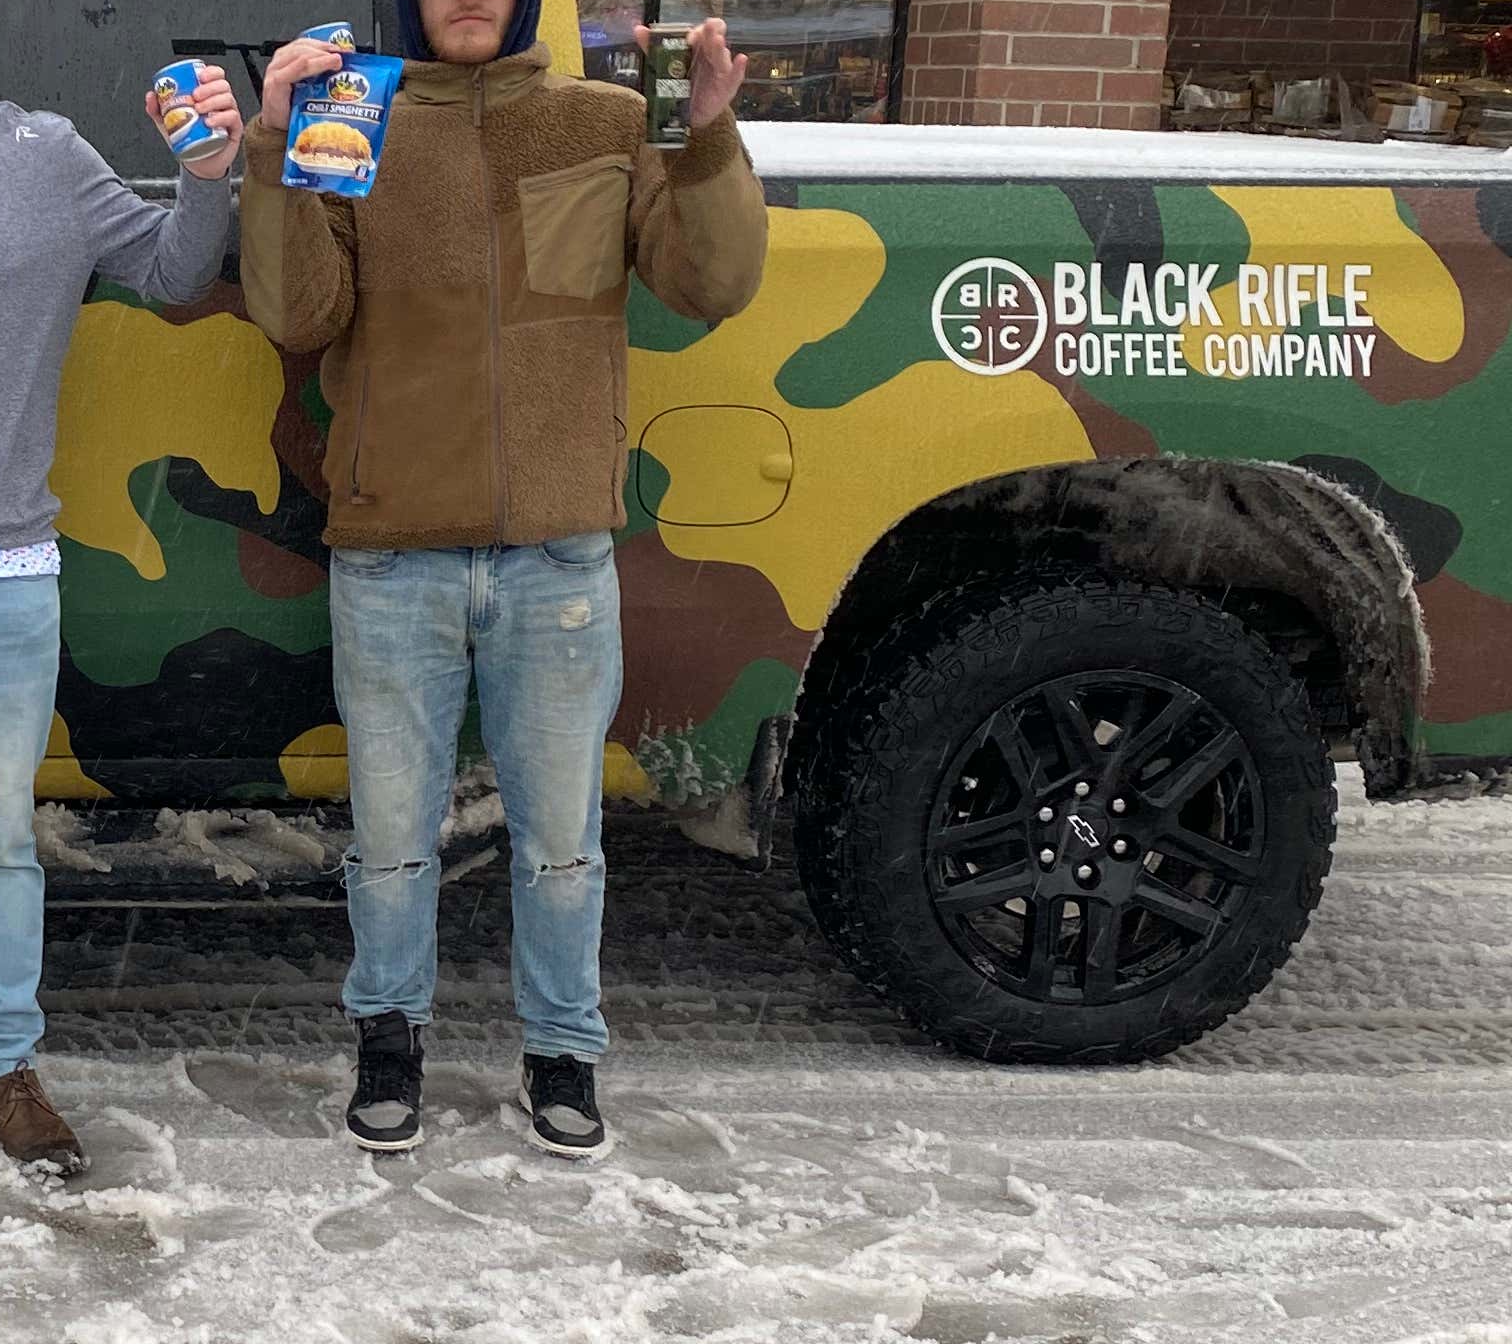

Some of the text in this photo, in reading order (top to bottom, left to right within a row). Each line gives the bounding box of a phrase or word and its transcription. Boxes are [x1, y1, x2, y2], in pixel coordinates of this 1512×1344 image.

[306, 102, 380, 120] CHILI SPAGHETTI
[1053, 261, 1375, 328] BLACK RIFLE
[1054, 332, 1377, 378] COFFEE COMPANY
